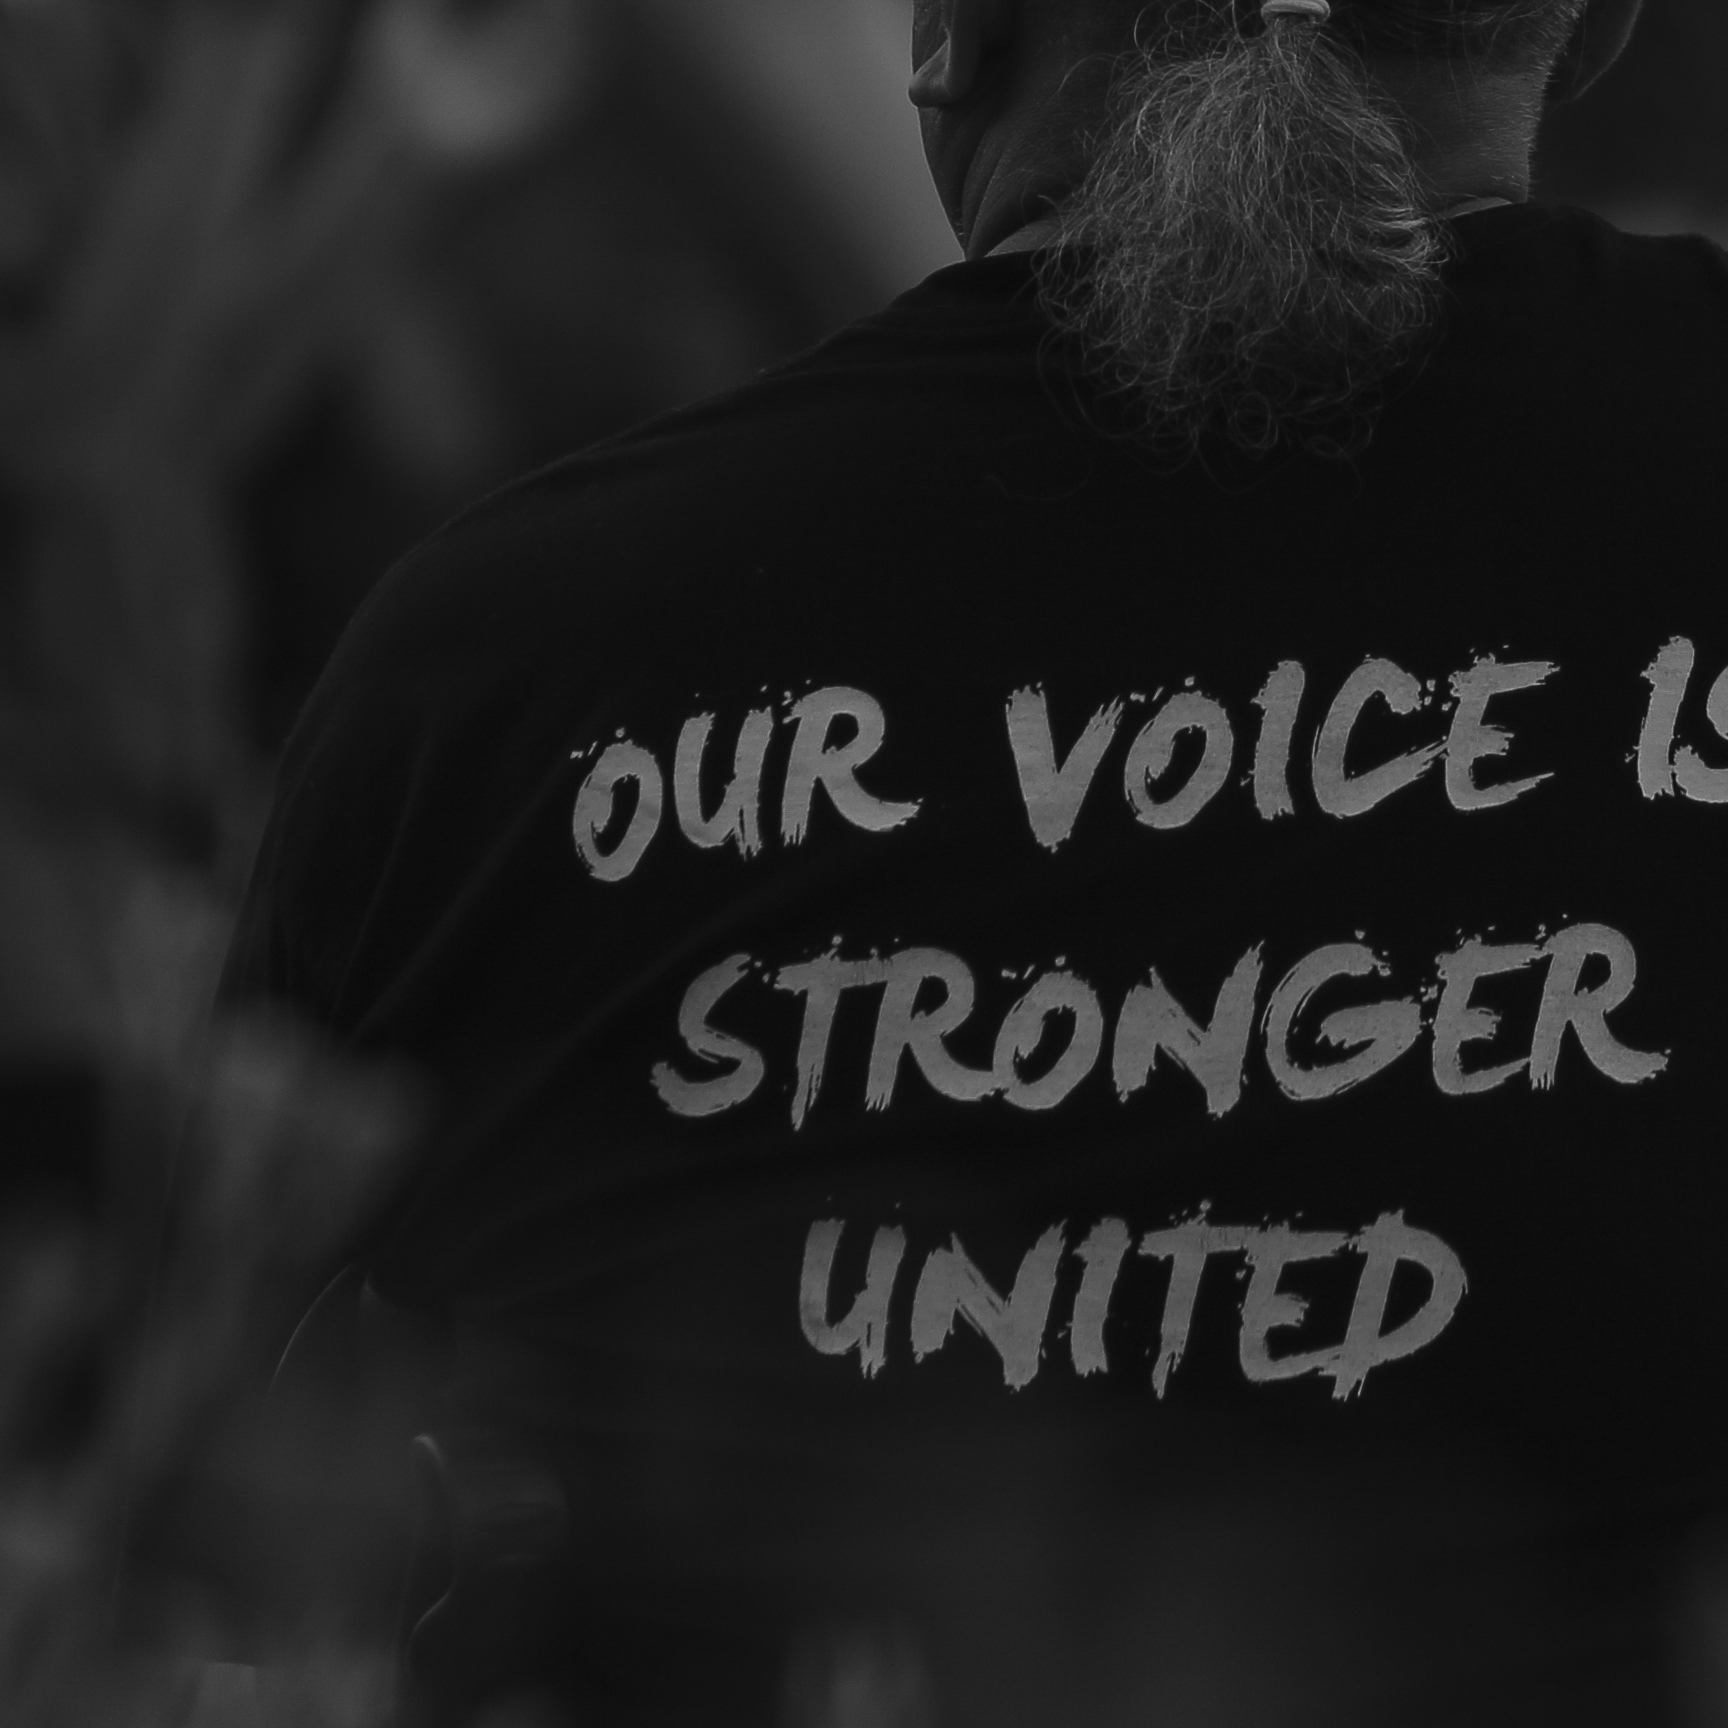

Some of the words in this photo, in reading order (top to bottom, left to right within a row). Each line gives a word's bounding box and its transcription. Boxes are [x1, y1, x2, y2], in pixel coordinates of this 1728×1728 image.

[571, 684, 922, 882] OUR
[1004, 651, 1560, 854] VOICE
[652, 922, 1670, 1132] STRONGER
[798, 1208, 1470, 1402] UNITED
